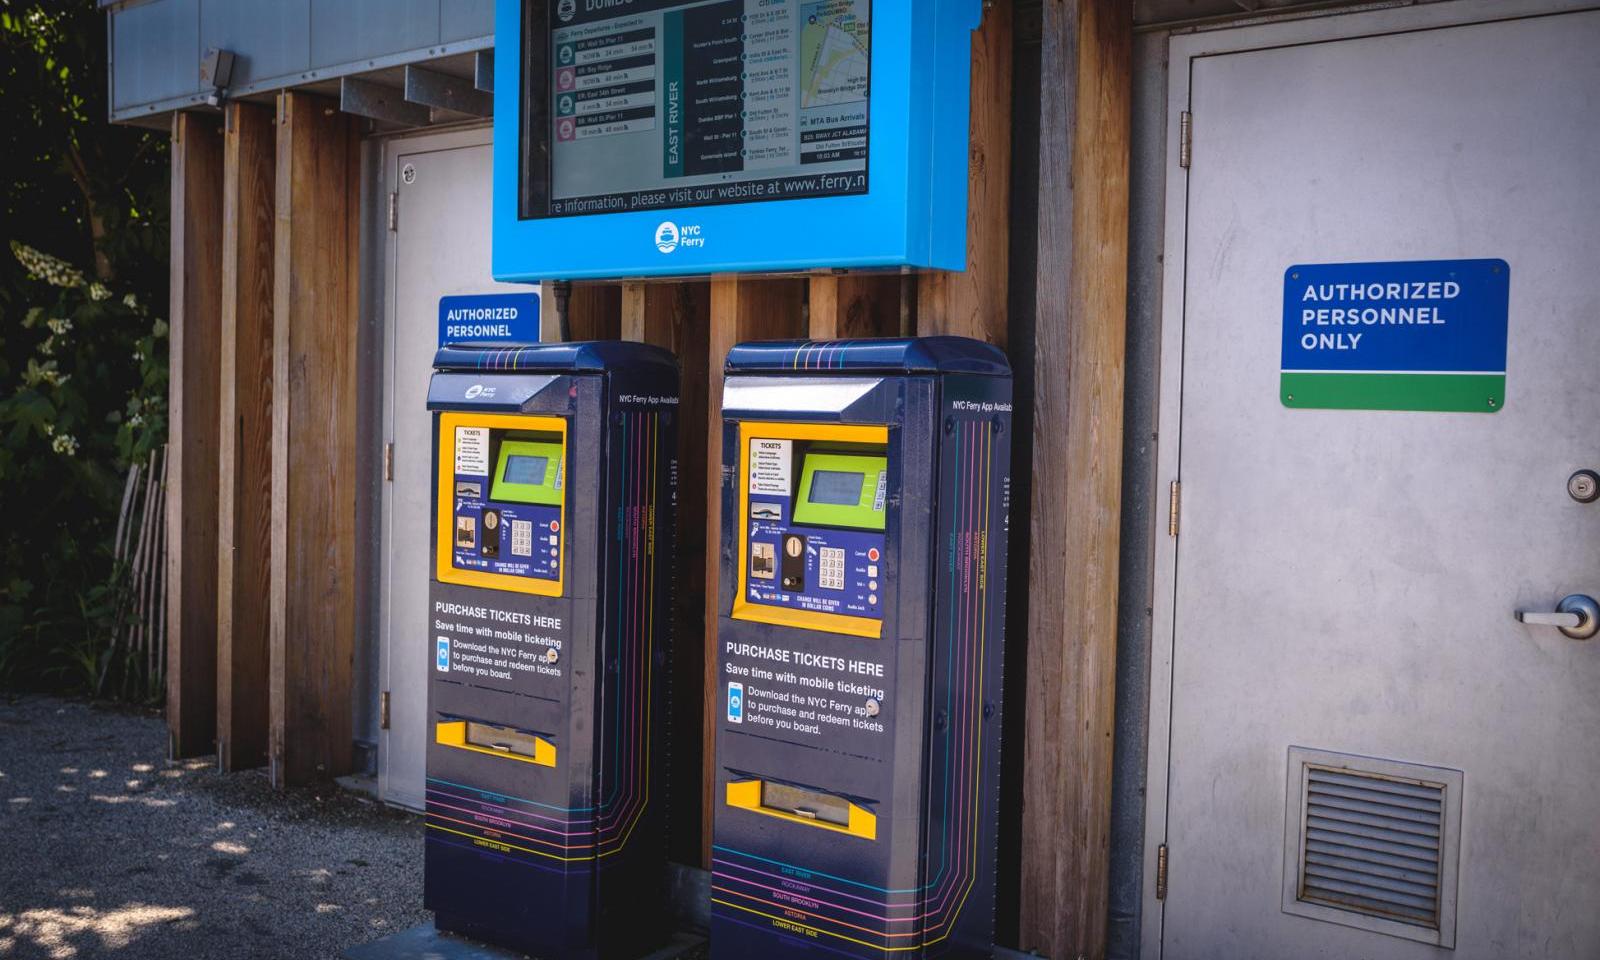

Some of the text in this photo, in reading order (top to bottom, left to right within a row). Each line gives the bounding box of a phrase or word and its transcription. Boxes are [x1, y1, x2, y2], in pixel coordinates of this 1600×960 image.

[586, 0, 633, 11] DUM
[669, 81, 678, 164] EAST RIVER
[840, 112, 865, 122] Arrivals
[565, 196, 628, 213] information,
[631, 191, 665, 209] please
[669, 187, 693, 202] visit
[696, 187, 715, 201] our
[718, 182, 764, 200] website
[768, 181, 780, 194] at
[784, 173, 865, 195] www.ferry.n
[681, 226, 701, 236] NYC
[681, 236, 705, 248] Ferry
[1302, 281, 1461, 302] AUTHORIZED
[447, 307, 518, 321] AUTHORIZED
[1302, 307, 1446, 326] PERSONNEL
[447, 325, 512, 337] PERSONNEL
[1301, 333, 1362, 350] ONLY
[619, 395, 632, 403] NYC
[633, 395, 646, 405] Ferry
[647, 396, 658, 404] App
[953, 401, 965, 410] NYC
[967, 401, 980, 412] Ferry
[982, 402, 993, 411] App
[435, 601, 561, 630] PURCHASE TICKETS HERE
[435, 620, 562, 649] Save time with mobile ticketing
[453, 639, 487, 652] Download
[488, 645, 500, 654] the
[501, 647, 517, 656] NYC
[518, 650, 536, 662] Ferry
[726, 642, 884, 677] PURCHASE TICKETS HERE
[453, 651, 561, 677] to purchase and redeem tickets
[453, 663, 512, 680] before you board.
[725, 663, 884, 700] Save time with mobile ticketing
[748, 686, 789, 702] Download
[791, 693, 805, 704] the
[807, 697, 827, 708] NYC
[829, 700, 852, 716] Ferry
[747, 713, 821, 734] before you board.
[748, 700, 884, 732] to purchase and redeem tickets
[781, 867, 794, 876] EAST
[781, 880, 811, 893] ROCKAWAY
[773, 892, 819, 910] SOUTH BROOKLYN
[784, 909, 807, 921] ASTORIA
[772, 919, 818, 938] LOWER EAST SIDE
